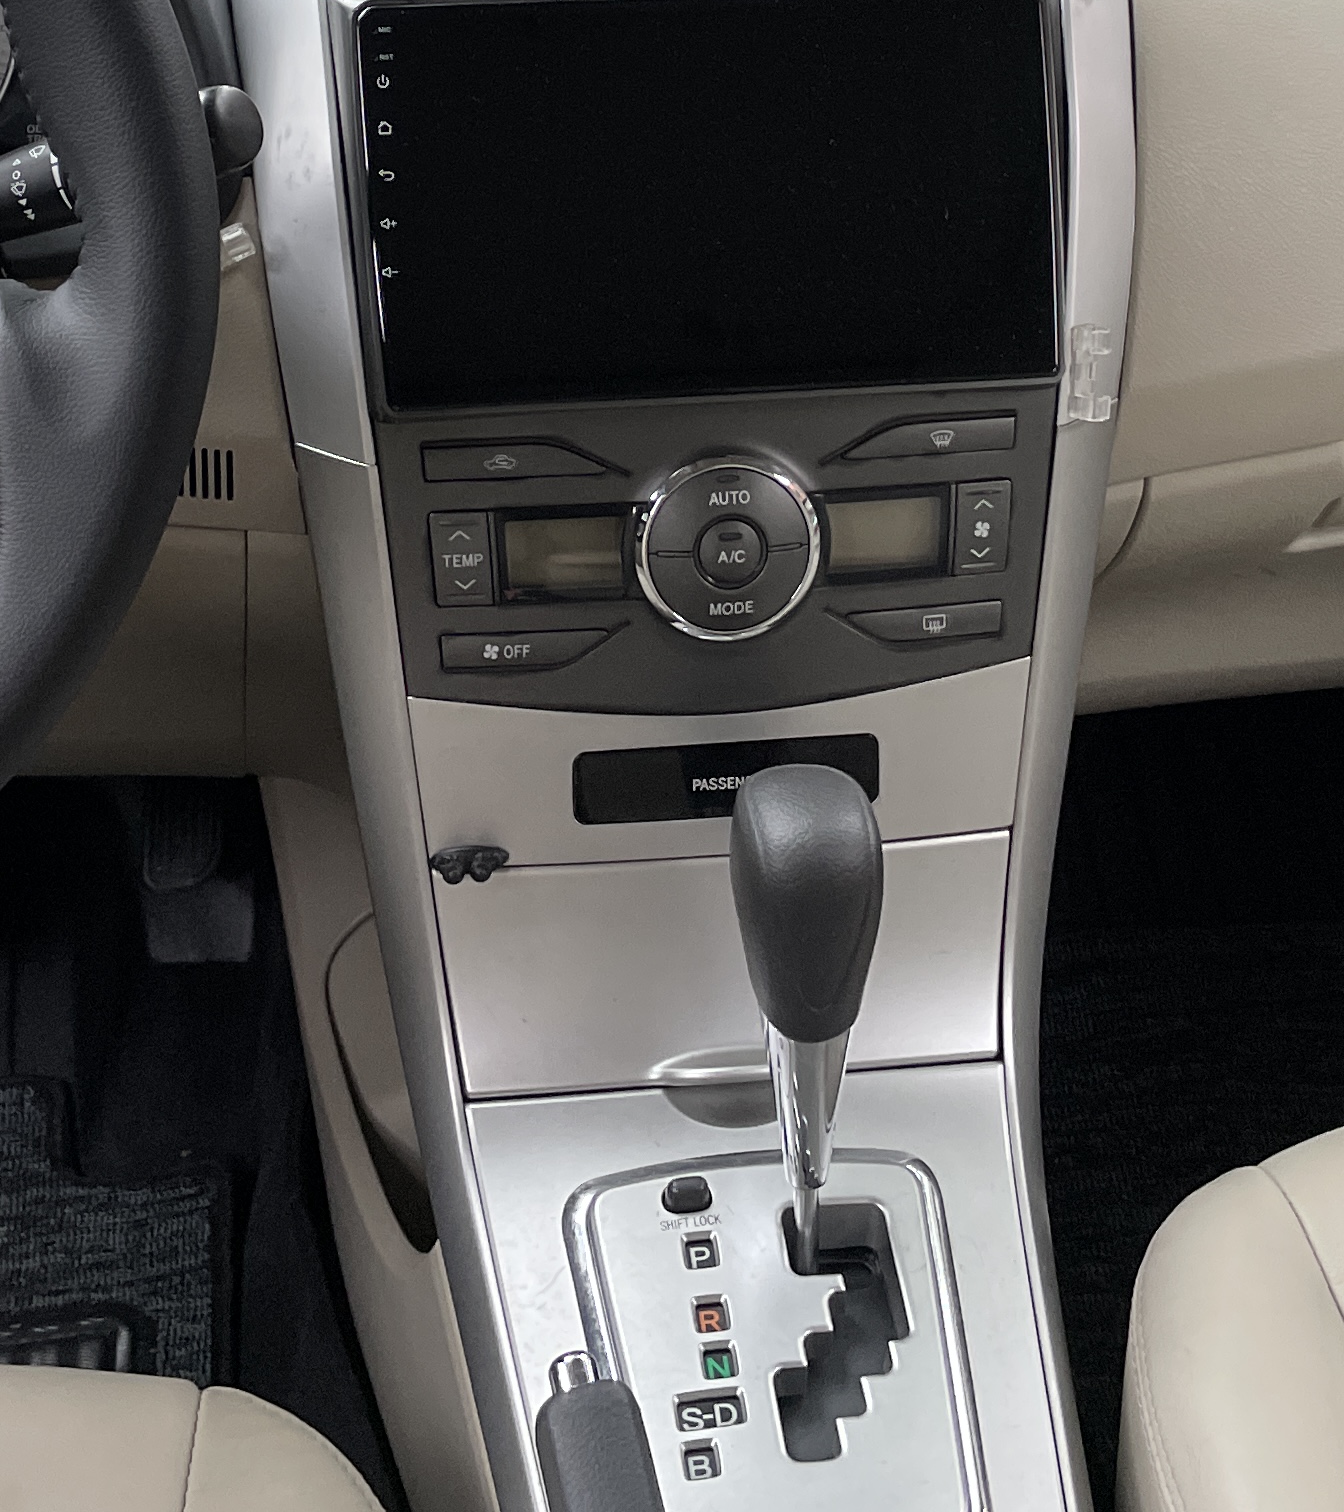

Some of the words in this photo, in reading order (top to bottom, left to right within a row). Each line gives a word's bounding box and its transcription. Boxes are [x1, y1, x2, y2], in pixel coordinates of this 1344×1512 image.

[709, 490, 750, 506] AUTO
[442, 554, 484, 568] TEMP
[718, 551, 746, 564] A/C
[709, 600, 754, 616] MODE
[503, 645, 530, 658] OFF
[659, 1218, 690, 1232] SHIFT
[693, 1213, 722, 1227] LOCK
[689, 1246, 711, 1269] P
[698, 1310, 721, 1332] R
[706, 1355, 730, 1379] N
[681, 1403, 738, 1431] S-D
[687, 1455, 712, 1480] B
